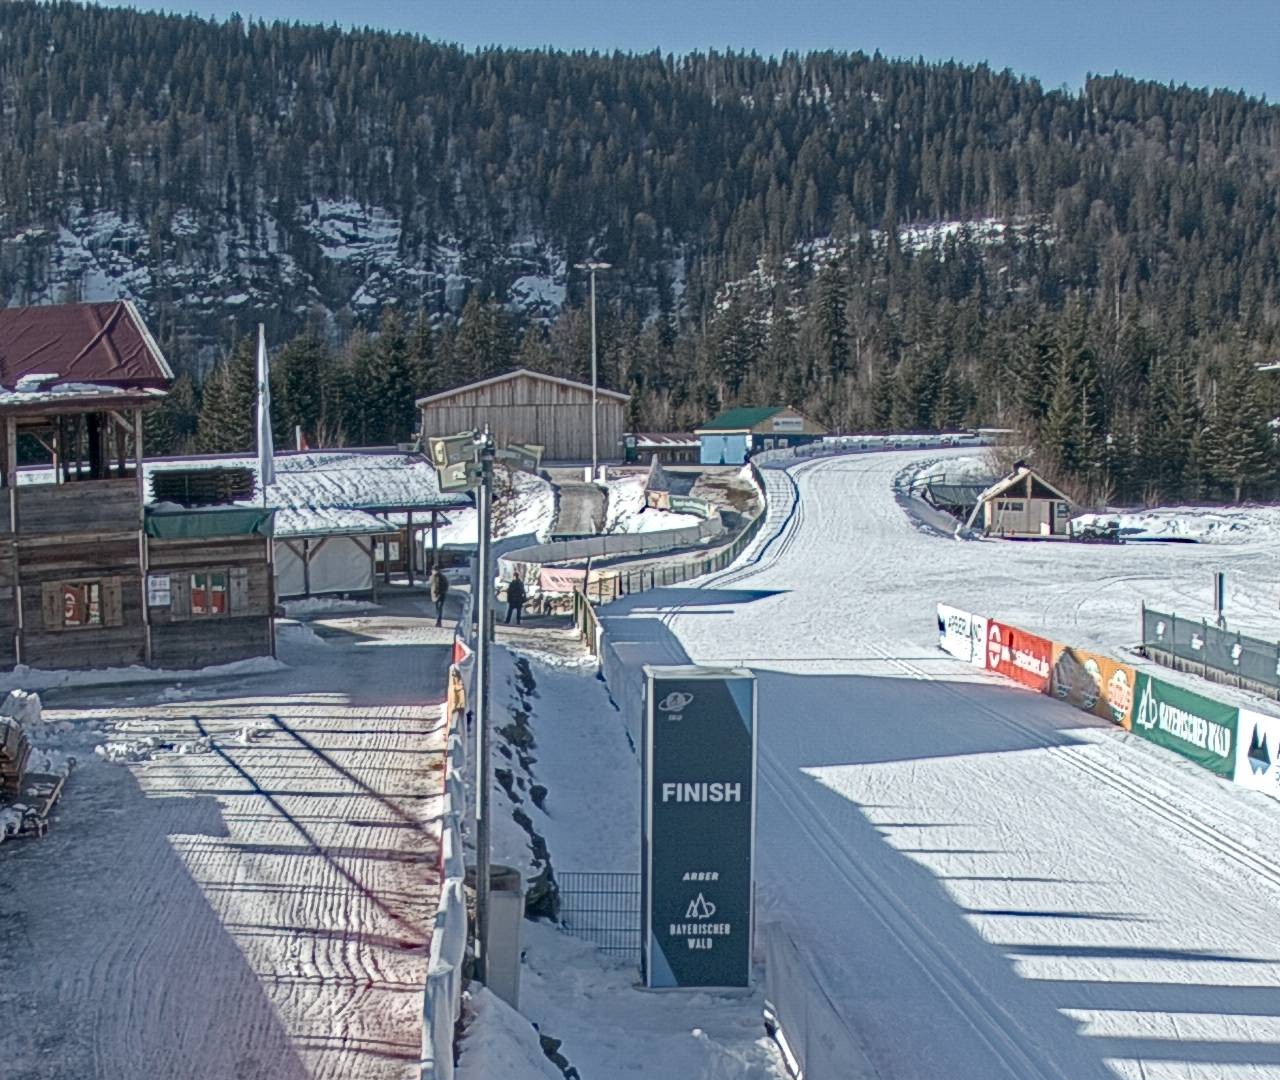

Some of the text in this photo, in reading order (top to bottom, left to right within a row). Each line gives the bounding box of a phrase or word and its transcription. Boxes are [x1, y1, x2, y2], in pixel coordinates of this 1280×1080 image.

[662, 783, 741, 803] FINISH
[670, 924, 730, 936] BAYERISCHER
[687, 938, 712, 950] WALD
